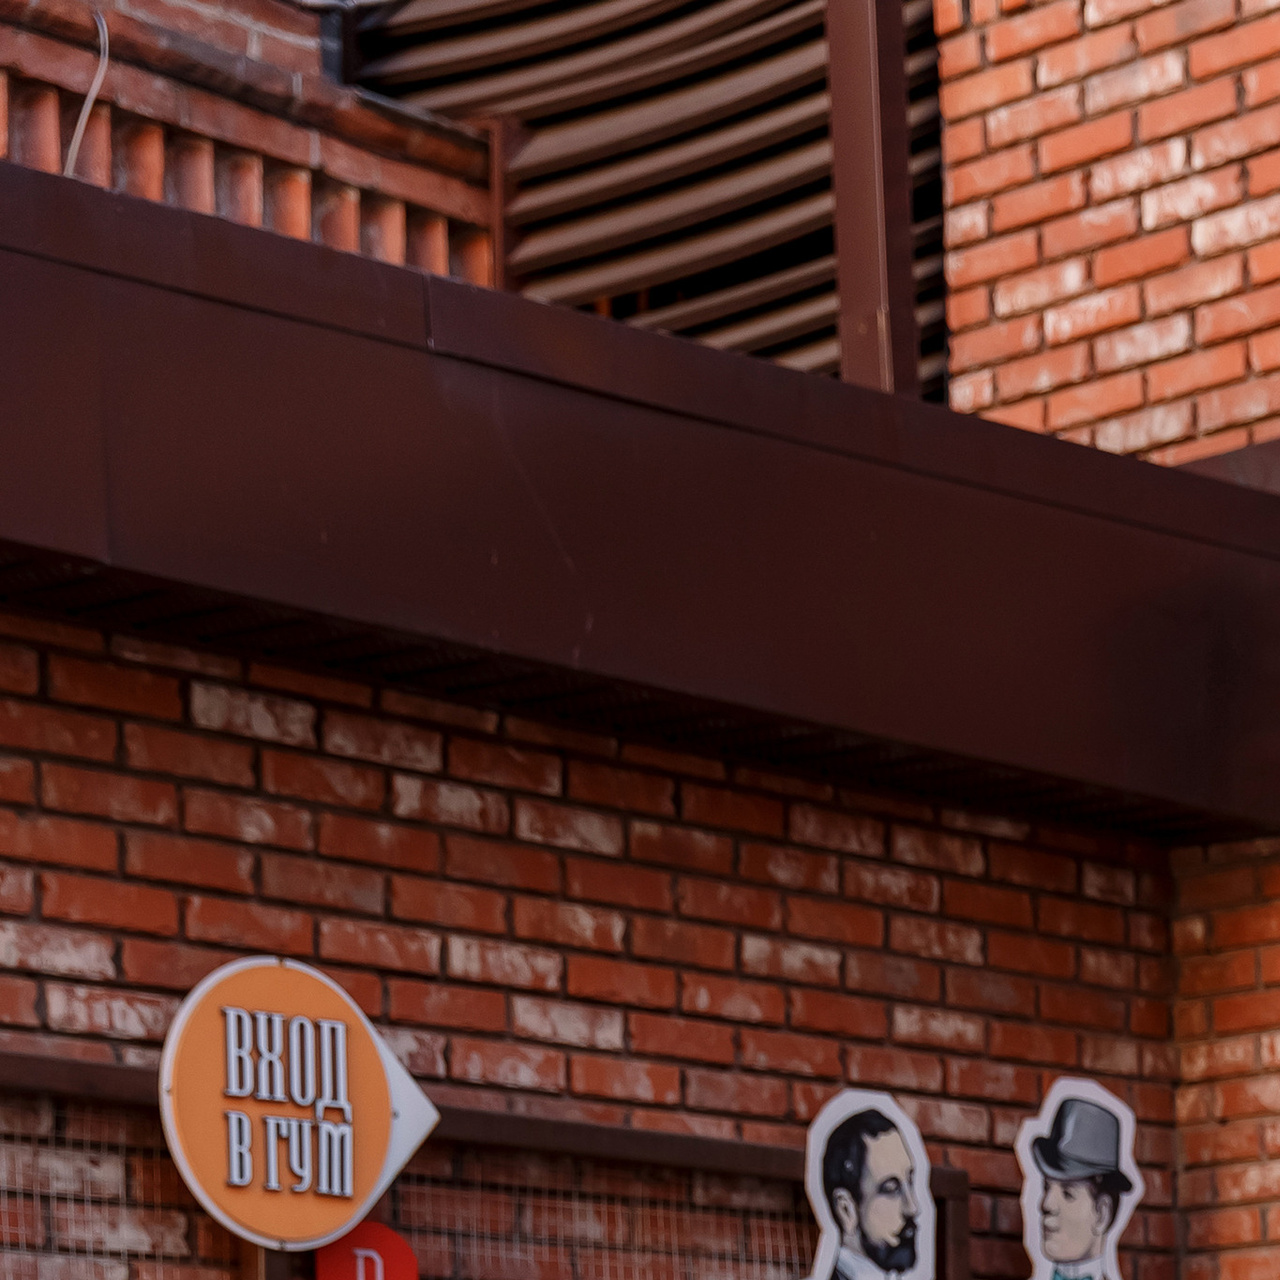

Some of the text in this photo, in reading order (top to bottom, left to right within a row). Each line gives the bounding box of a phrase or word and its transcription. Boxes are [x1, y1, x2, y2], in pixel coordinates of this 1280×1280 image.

[221, 1006, 353, 1123] ВХОД
[225, 1110, 354, 1198] В ГУМ
